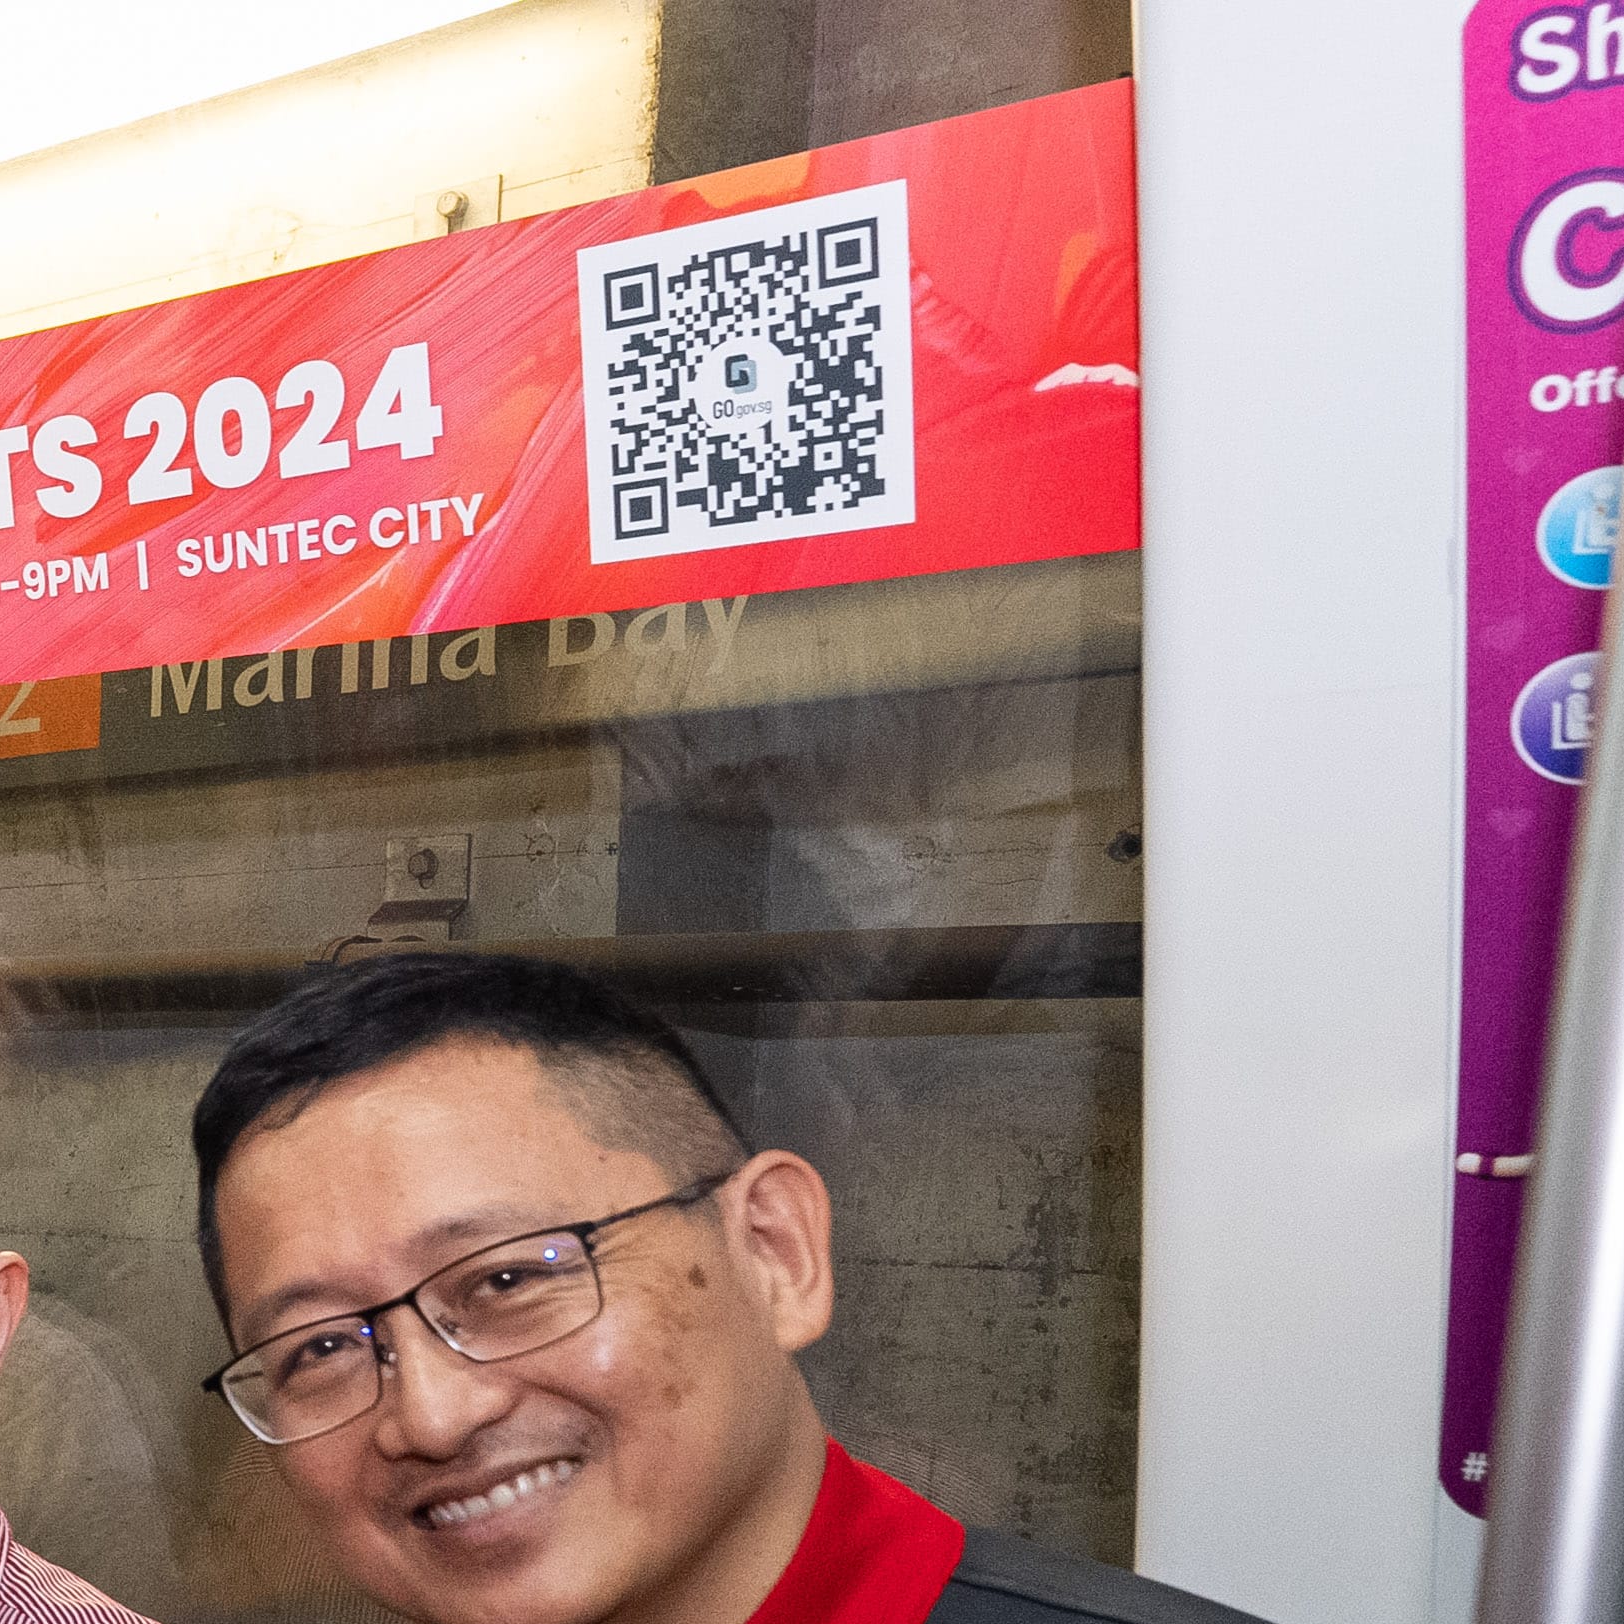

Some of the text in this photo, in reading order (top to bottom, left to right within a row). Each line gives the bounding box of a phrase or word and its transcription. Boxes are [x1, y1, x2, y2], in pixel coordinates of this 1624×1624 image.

[122, 341, 444, 505] 2024
[175, 513, 358, 580] SUNTEC
[369, 491, 485, 549] CITY
